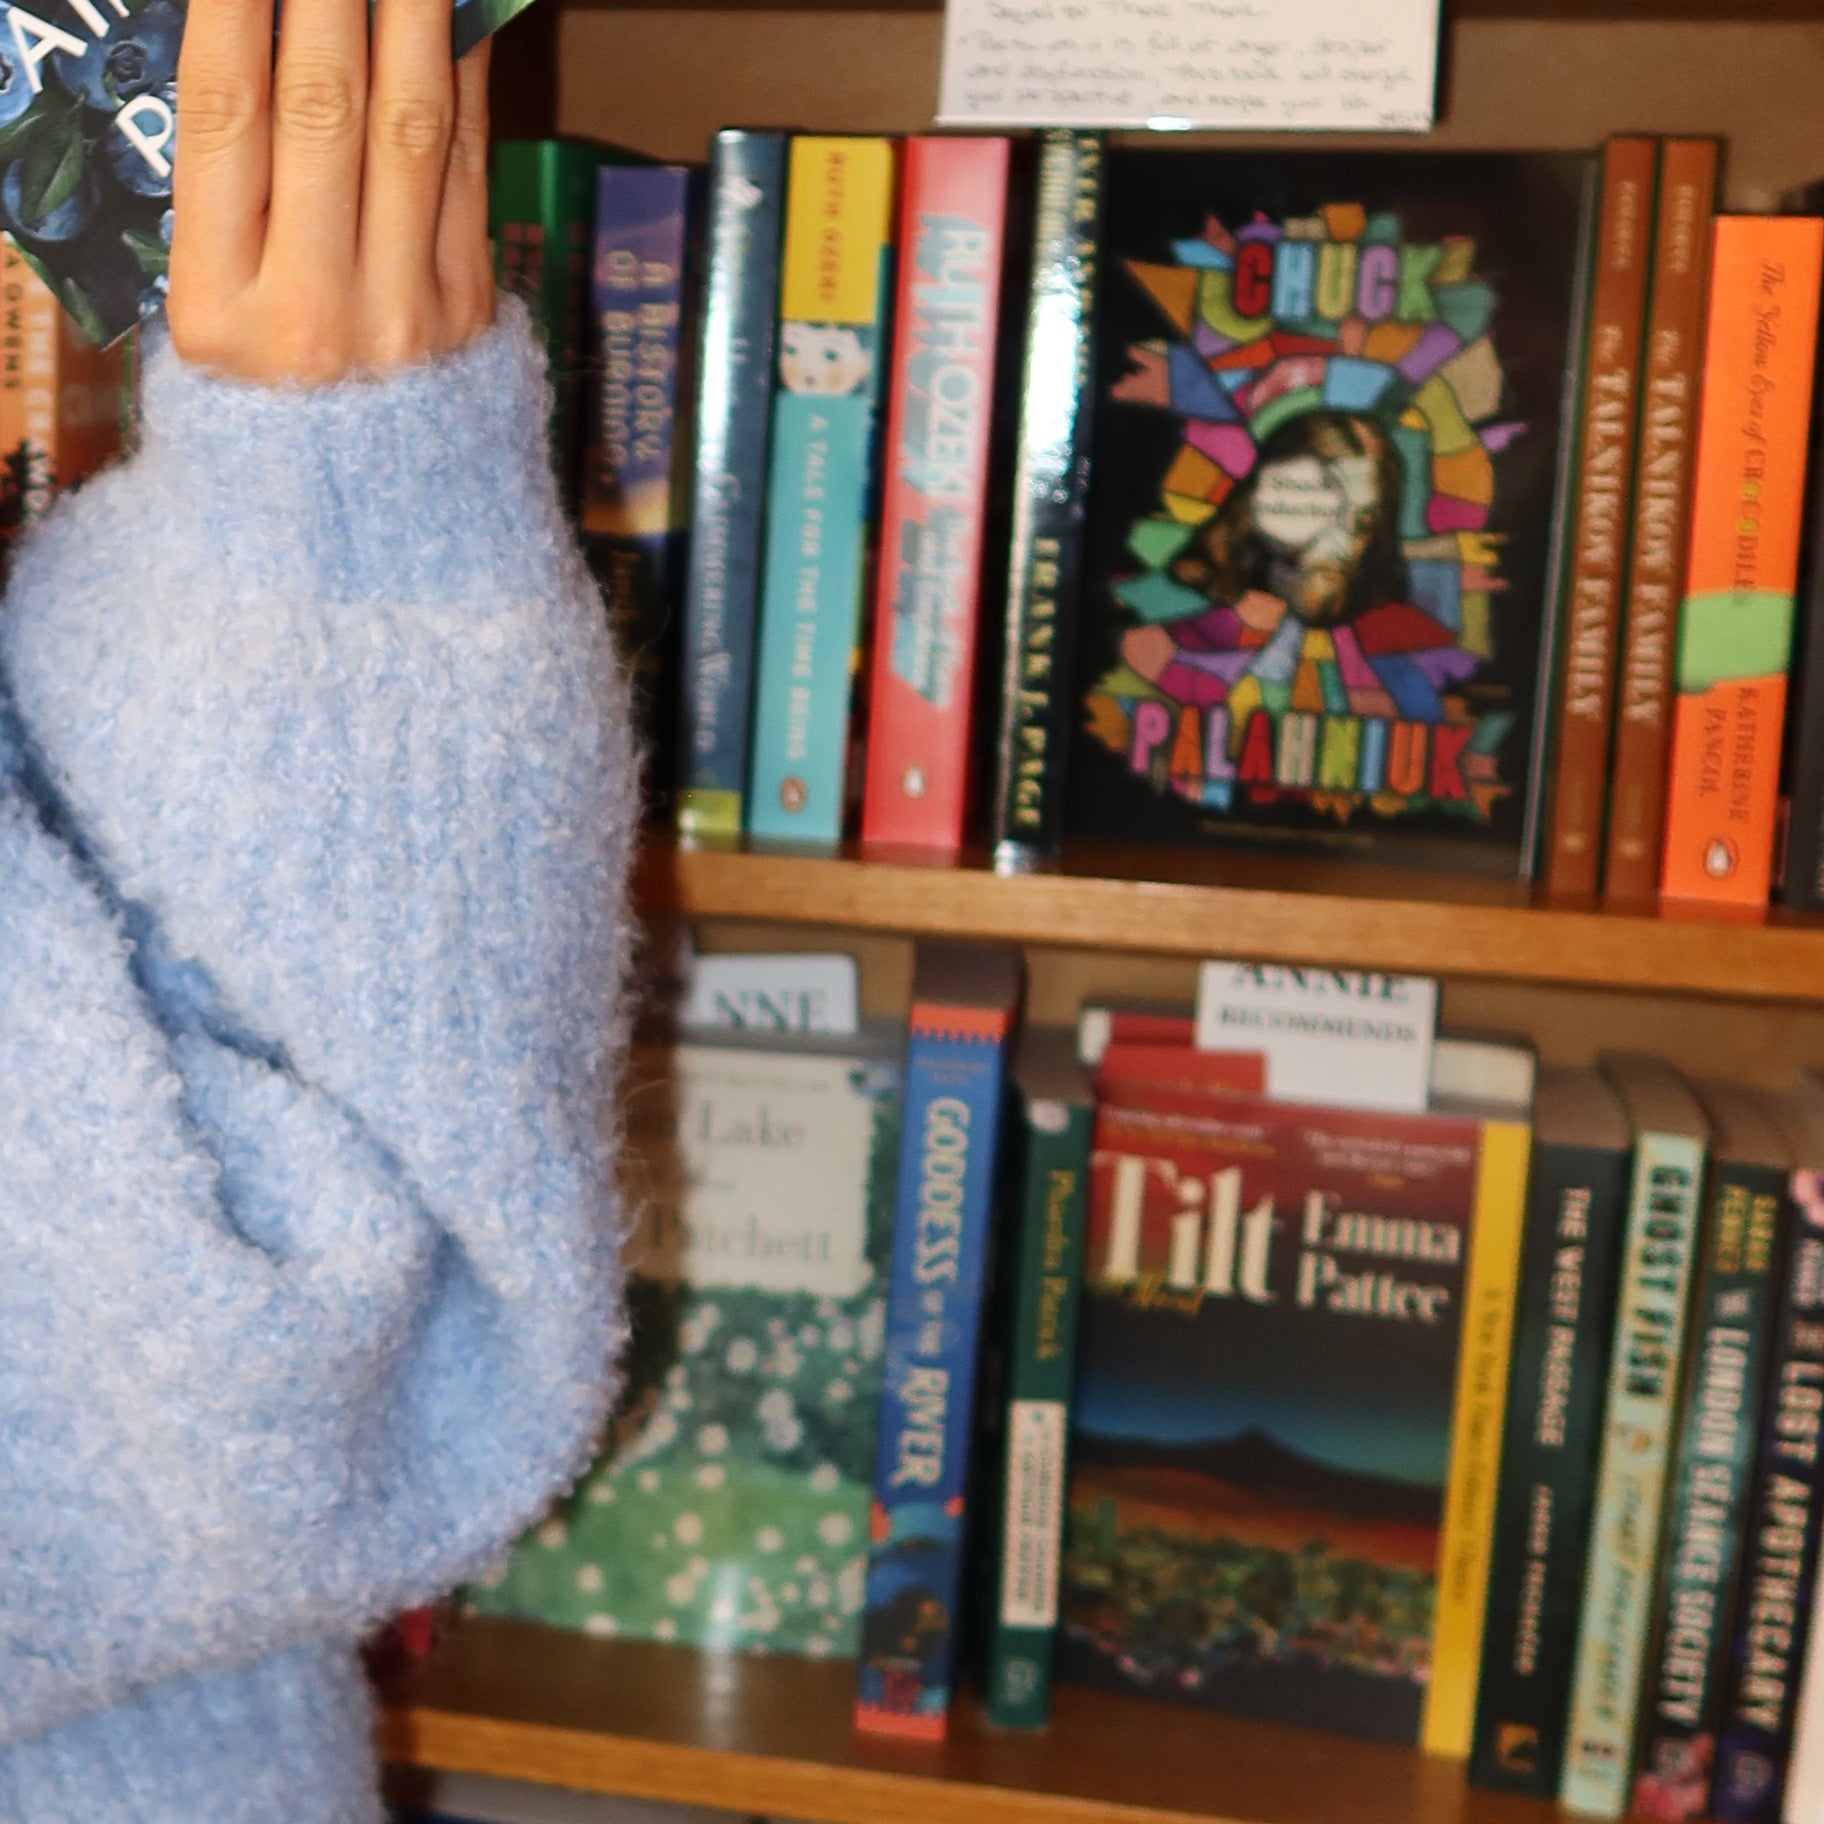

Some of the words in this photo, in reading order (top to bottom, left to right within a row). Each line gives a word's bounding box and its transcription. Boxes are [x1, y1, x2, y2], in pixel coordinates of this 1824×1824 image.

[929, 227, 990, 360] RUTH
[1232, 239, 1447, 321] CHUCK
[801, 440, 827, 501] TALE
[806, 412, 829, 432] A
[922, 363, 981, 502] OZEKI
[1581, 367, 1631, 568] TALNIKOV
[1637, 372, 1688, 570] TALNIKOV
[798, 507, 823, 557] FOR
[796, 566, 821, 613] THE
[1024, 538, 1061, 680] FRANK
[791, 620, 818, 677] TIME
[1567, 575, 1619, 723] FAMILY
[1623, 581, 1675, 727] FAMILY
[785, 684, 810, 760] BEING
[1013, 724, 1048, 827] PAGE
[1129, 699, 1472, 801] PALAHNIUK
[1217, 1004, 1418, 1044] RECOMMENDS
[911, 1095, 972, 1287] GODDESS
[1091, 1148, 1285, 1308] Tilt
[1302, 1189, 1460, 1265] Emma
[1639, 1163, 1692, 1294] GHOST
[1297, 1250, 1449, 1325] Pattee
[1625, 1306, 1682, 1402] FISH
[1696, 1327, 1750, 1456] LONDON
[889, 1364, 953, 1488] RIVER
[1775, 1359, 1824, 1464] LOST
[1656, 1588, 1716, 1728] SOCIETY
[1736, 1472, 1810, 1733] APOTHECARY
